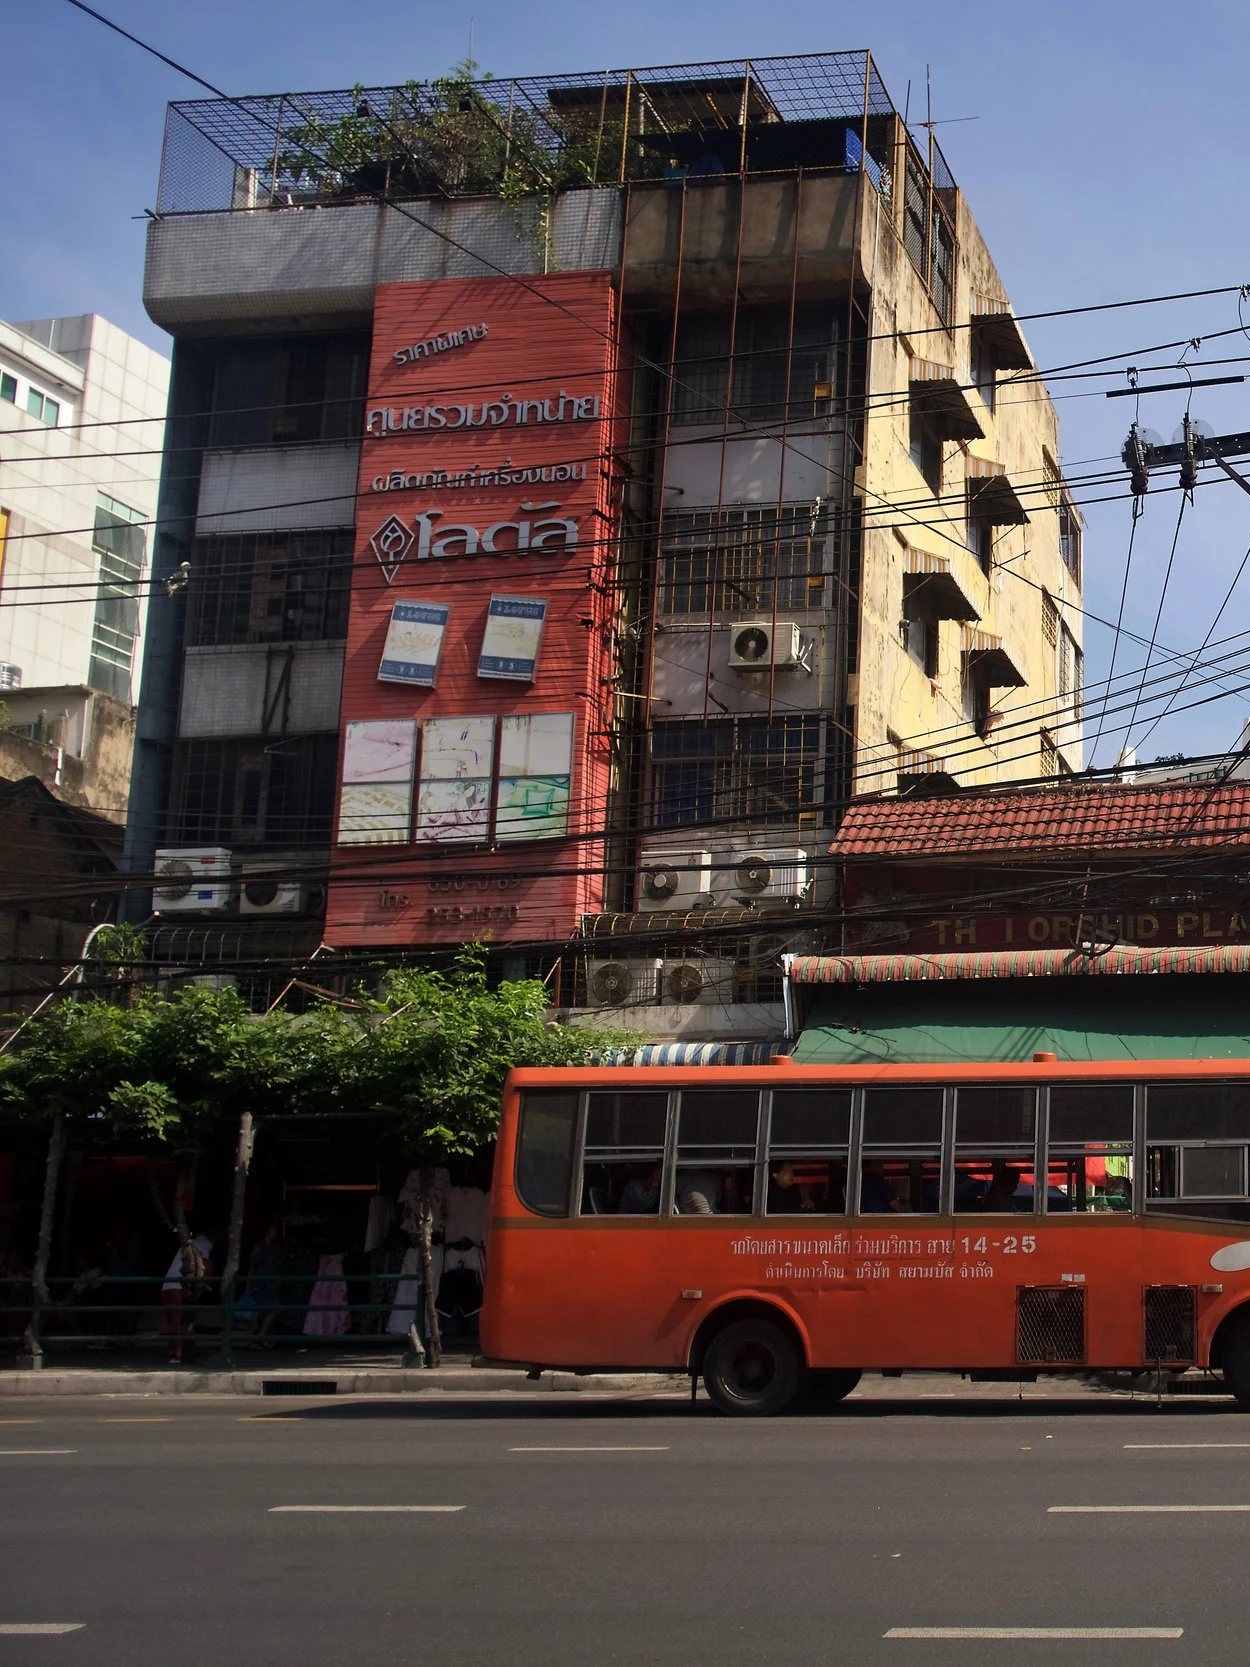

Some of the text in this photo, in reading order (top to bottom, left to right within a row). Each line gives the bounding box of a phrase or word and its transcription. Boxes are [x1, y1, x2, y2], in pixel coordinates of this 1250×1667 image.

[415, 501, 579, 560] โลตัส
[927, 1238, 956, 1255] สาย
[961, 1235, 1036, 1255] 14-25
[856, 1261, 890, 1279] บริษัท
[959, 1261, 994, 1279] จำกัด
